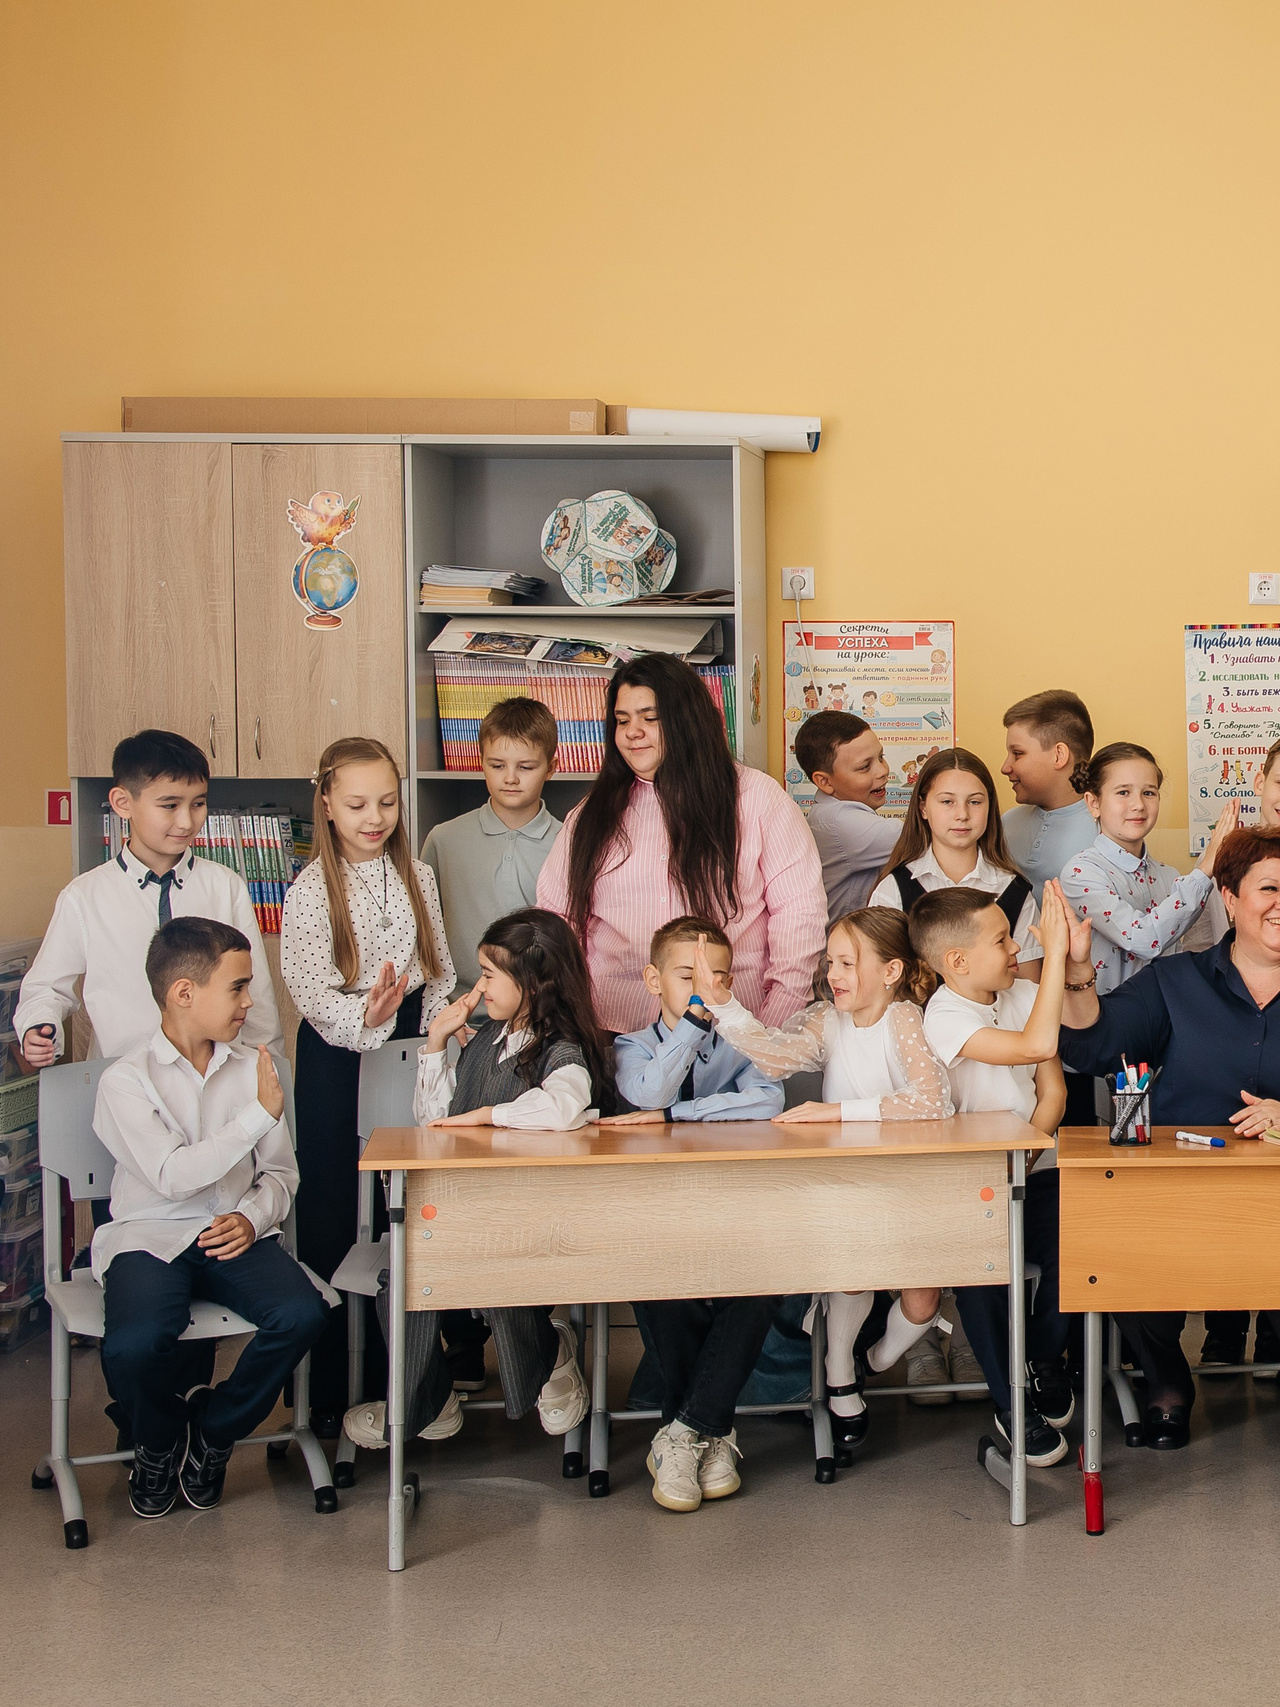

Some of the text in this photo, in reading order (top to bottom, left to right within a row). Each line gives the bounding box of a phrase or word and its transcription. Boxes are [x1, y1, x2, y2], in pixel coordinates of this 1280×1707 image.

[840, 624, 889, 635] Секреты
[837, 638, 889, 648] УСПЕХА
[1193, 632, 1252, 654] Правила
[853, 651, 890, 662] уроке:
[1209, 653, 1219, 664] 1.
[1222, 653, 1275, 666] Узнавать
[813, 666, 856, 674] выкрикивай
[1199, 671, 1210, 682] 2.
[1212, 673, 1270, 681] ИССЛЕДОВАТЬ
[1223, 687, 1233, 697] 3.
[1217, 702, 1228, 713] 4.
[1231, 702, 1273, 713] Уважать
[1203, 719, 1214, 729] 5.
[1218, 722, 1260, 730] Говорить
[1208, 745, 1269, 756] 6. НЕ БОЯТЬ
[1246, 762, 1256, 771] 7.
[1200, 787, 1256, 798] 8. Соблю
[1241, 805, 1256, 813] Не
